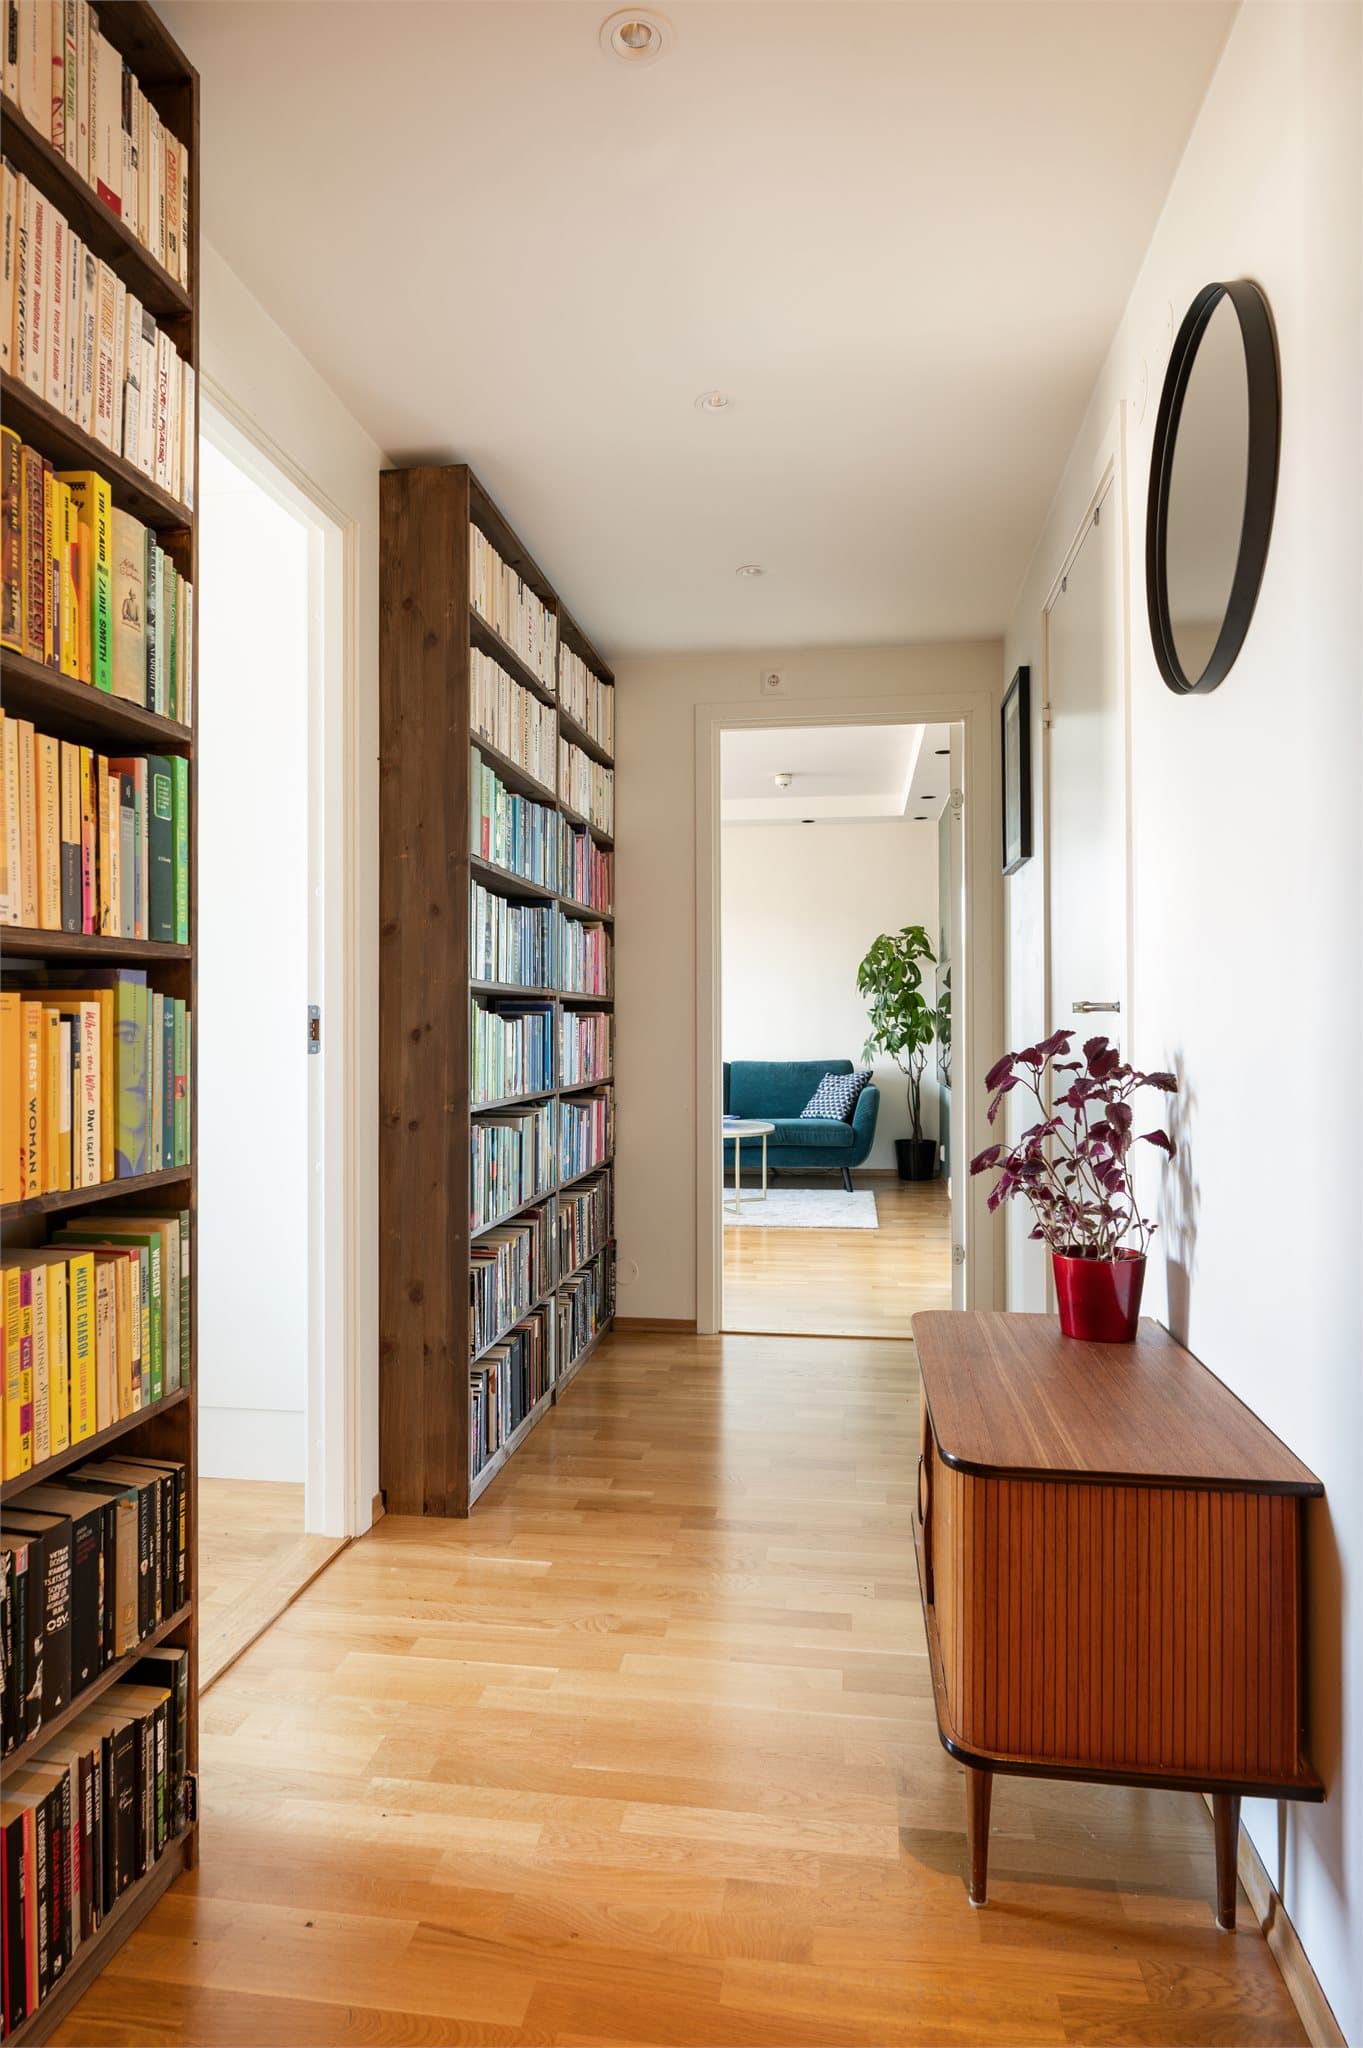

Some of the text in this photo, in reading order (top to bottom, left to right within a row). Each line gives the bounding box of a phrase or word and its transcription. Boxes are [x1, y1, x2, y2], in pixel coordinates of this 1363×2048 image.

[167, 149, 176, 226] CATCH-22
[33, 461, 44, 646] MICHAEL CHABON
[85, 1011, 96, 1040] What
[29, 1097, 37, 1174] WOMAN
[76, 1267, 88, 1312] MICHAEL
[152, 1247, 161, 1298] WRECKED
[35, 1292, 44, 1326] JOHN
[77, 1312, 88, 1359] CHABON
